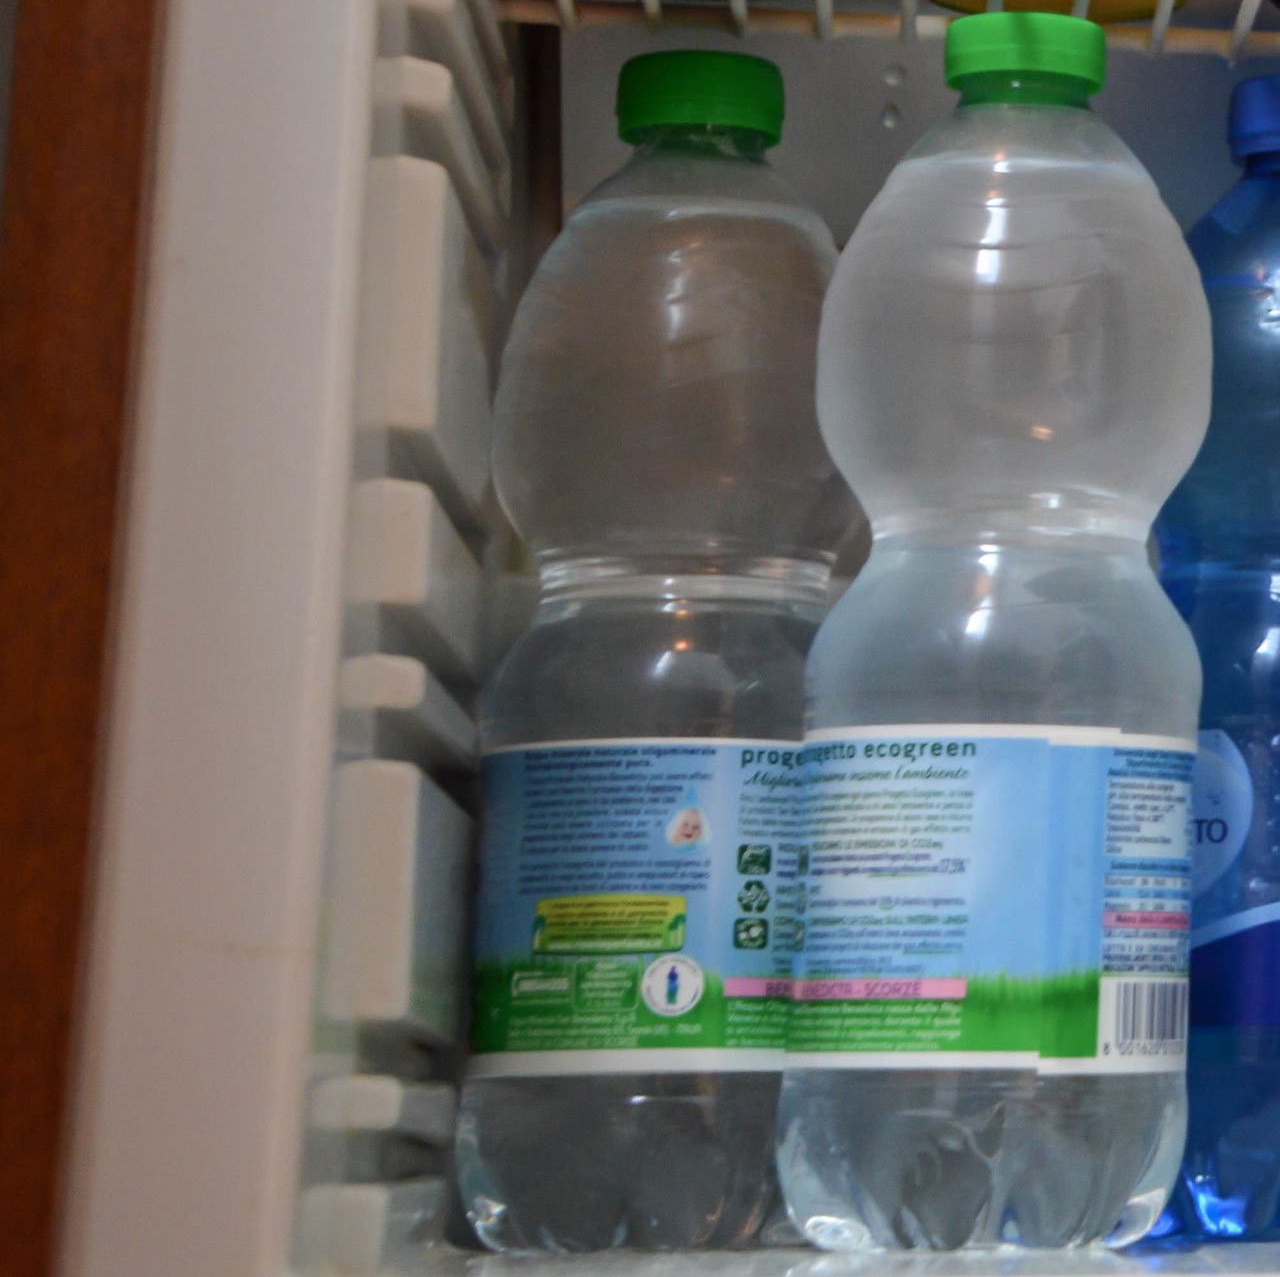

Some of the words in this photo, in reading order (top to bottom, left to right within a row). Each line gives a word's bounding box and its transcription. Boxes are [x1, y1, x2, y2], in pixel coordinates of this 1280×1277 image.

[742, 747, 804, 770] proge
[864, 741, 977, 762] ecogreen
[894, 763, 969, 780] l'ambiente
